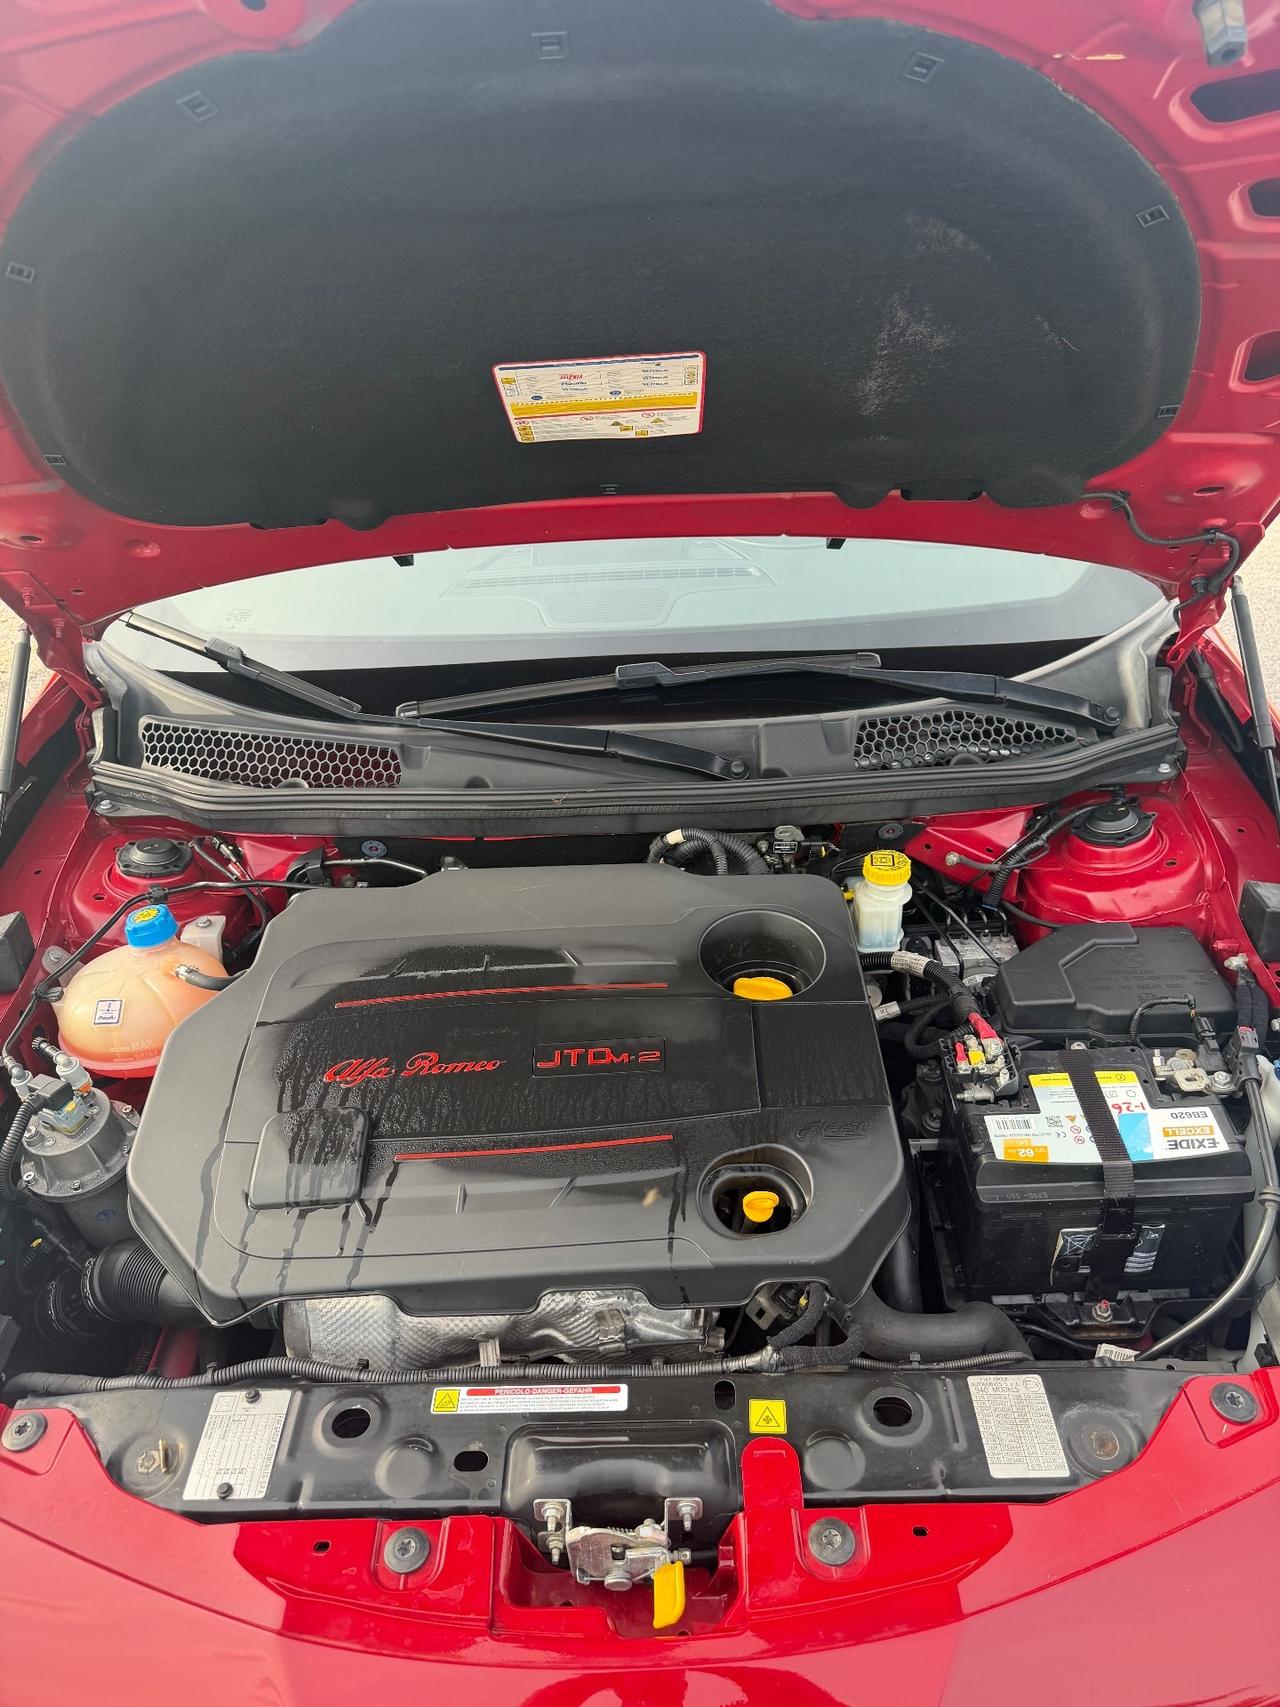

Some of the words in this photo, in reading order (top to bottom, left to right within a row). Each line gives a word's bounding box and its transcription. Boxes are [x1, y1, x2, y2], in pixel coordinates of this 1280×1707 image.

[322, 1056, 397, 1088] Alfa
[400, 1052, 504, 1077] Romeo
[1170, 1110, 1208, 1120] EB620
[1168, 1126, 1211, 1137] EXCELL
[1168, 1137, 1220, 1150] EXIDE
[1016, 1148, 1035, 1158] 62
